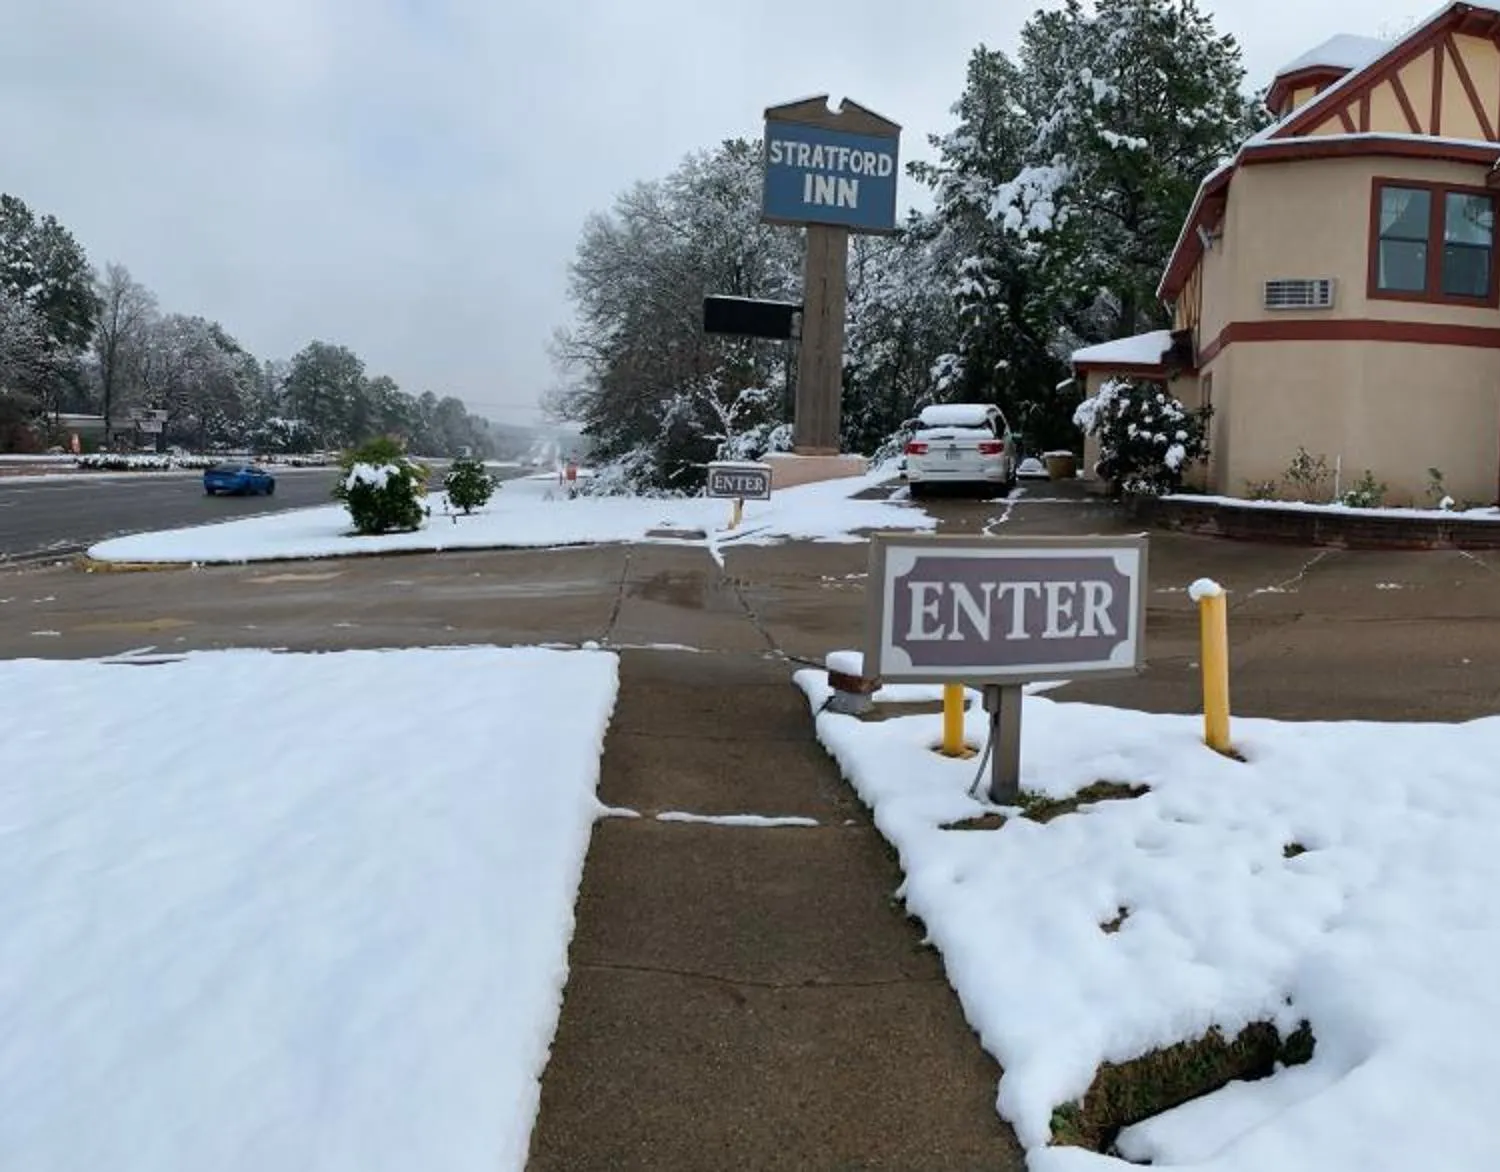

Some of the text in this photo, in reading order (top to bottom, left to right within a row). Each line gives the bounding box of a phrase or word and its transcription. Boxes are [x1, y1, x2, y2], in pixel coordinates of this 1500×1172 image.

[771, 140, 893, 177] STRATFORD
[803, 174, 859, 209] INN
[714, 475, 763, 491] ENTER
[905, 581, 1117, 641] ENTER
